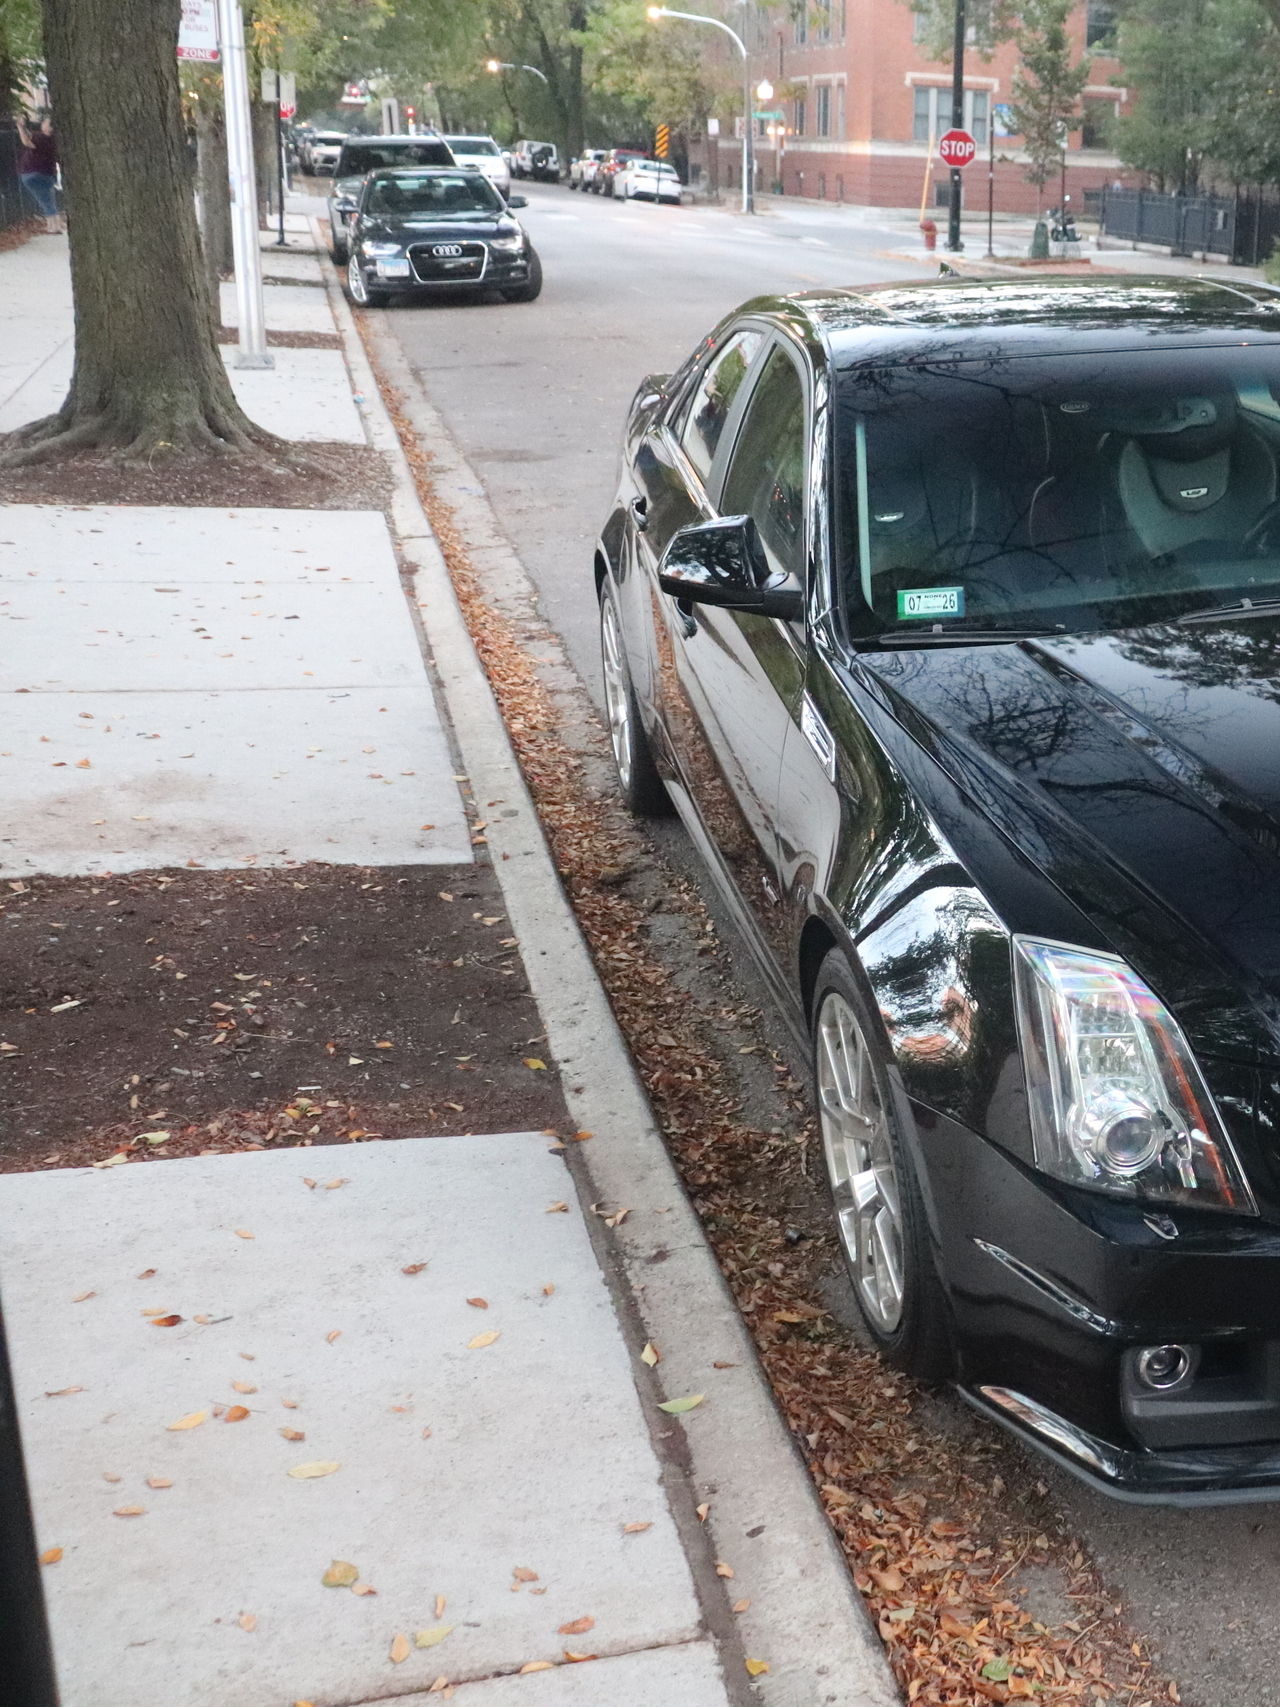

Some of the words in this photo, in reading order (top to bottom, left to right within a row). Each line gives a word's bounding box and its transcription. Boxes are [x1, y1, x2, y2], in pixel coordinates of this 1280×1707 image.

[184, 23, 209, 32] BUSES
[182, 48, 212, 59] ZONE
[941, 140, 974, 157] STOP
[908, 595, 922, 611] 07
[942, 593, 956, 609] 26
